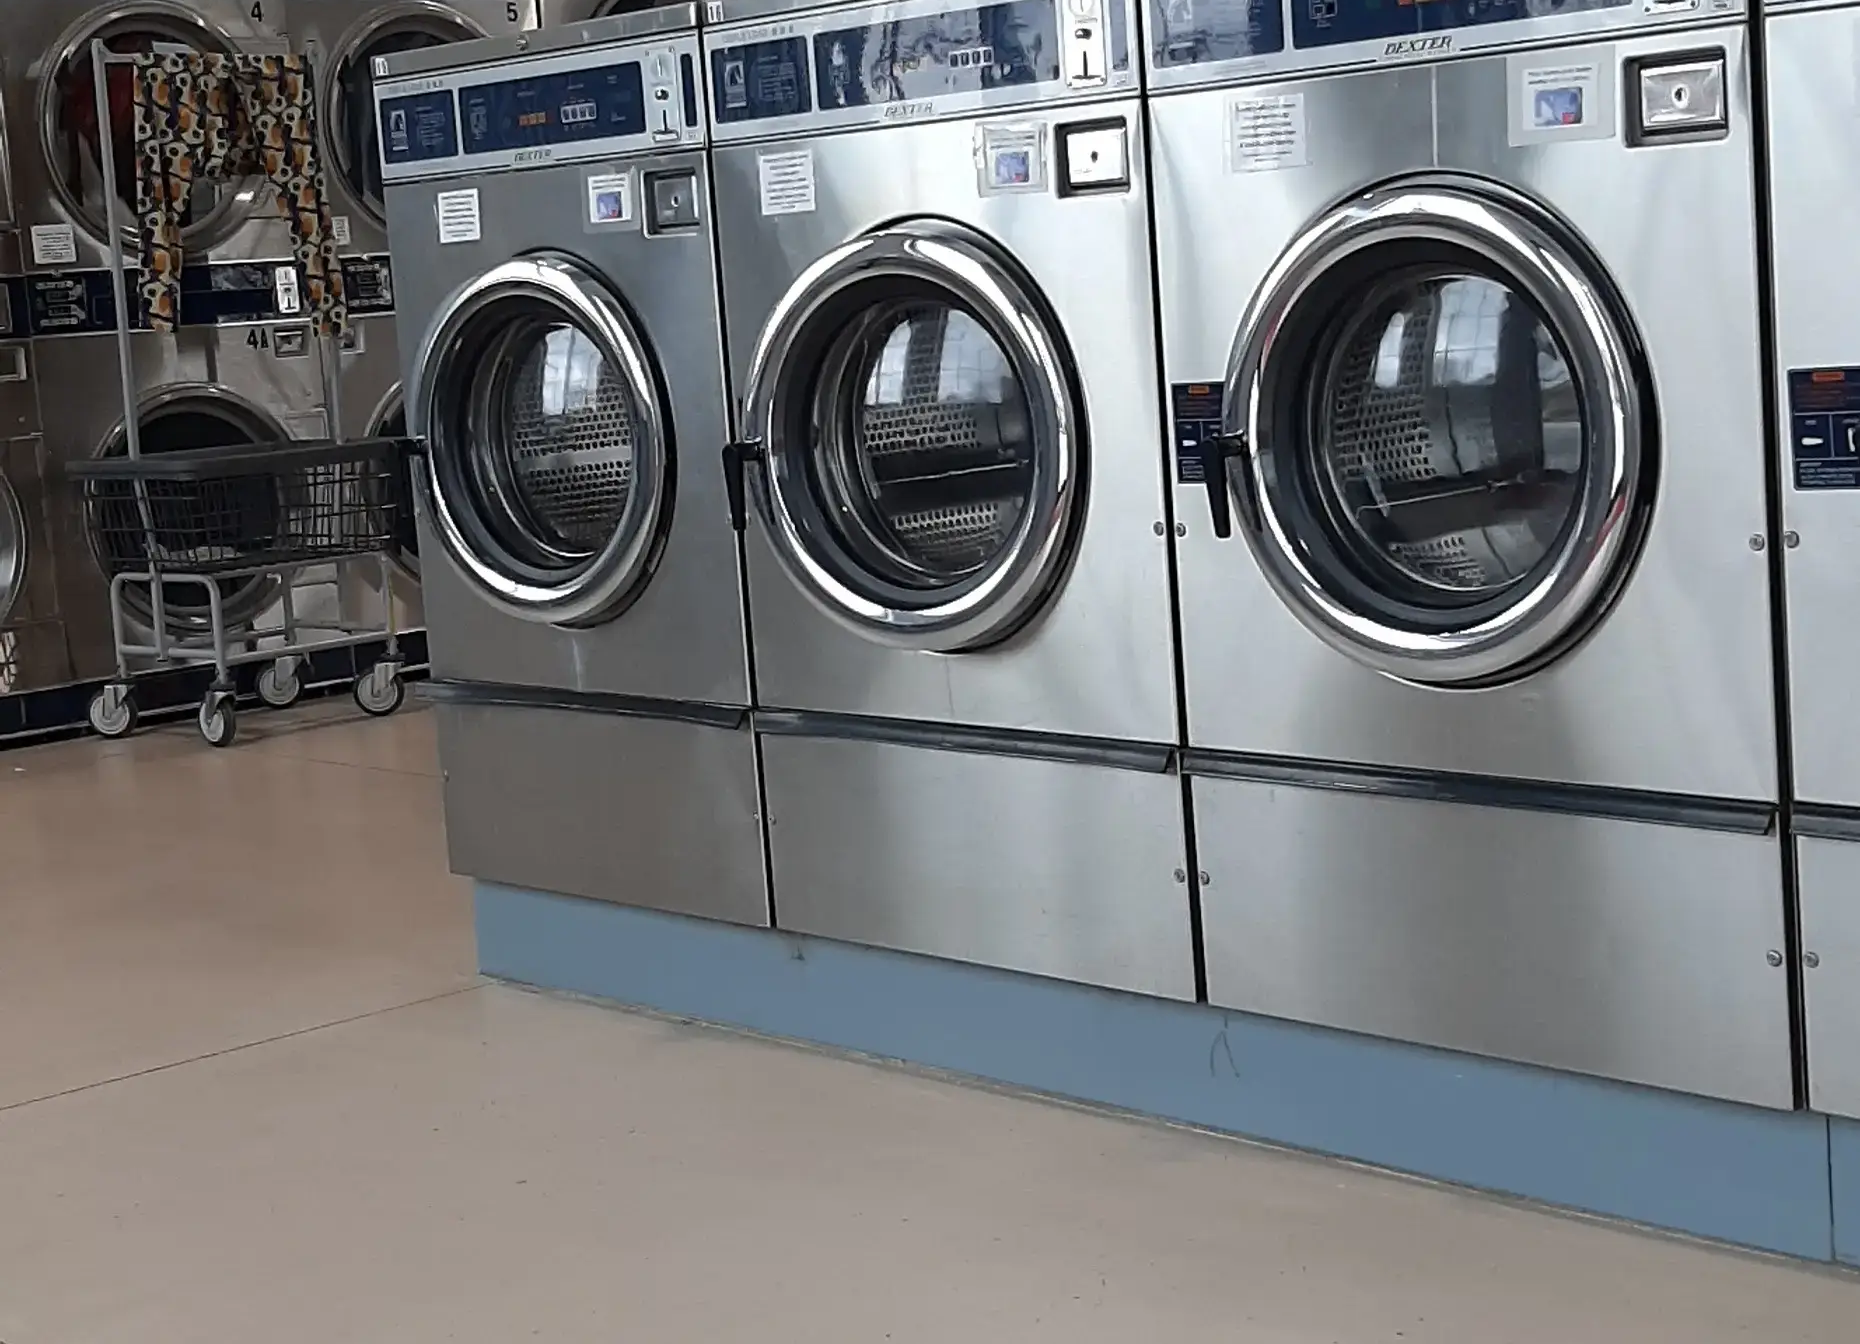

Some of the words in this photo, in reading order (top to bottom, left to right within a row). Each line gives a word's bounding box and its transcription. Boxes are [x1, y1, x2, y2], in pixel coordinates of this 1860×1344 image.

[250, 0, 262, 23] 4
[507, 1, 518, 22] 5
[1384, 35, 1453, 56] DEXTER
[246, 327, 269, 351] 4A
